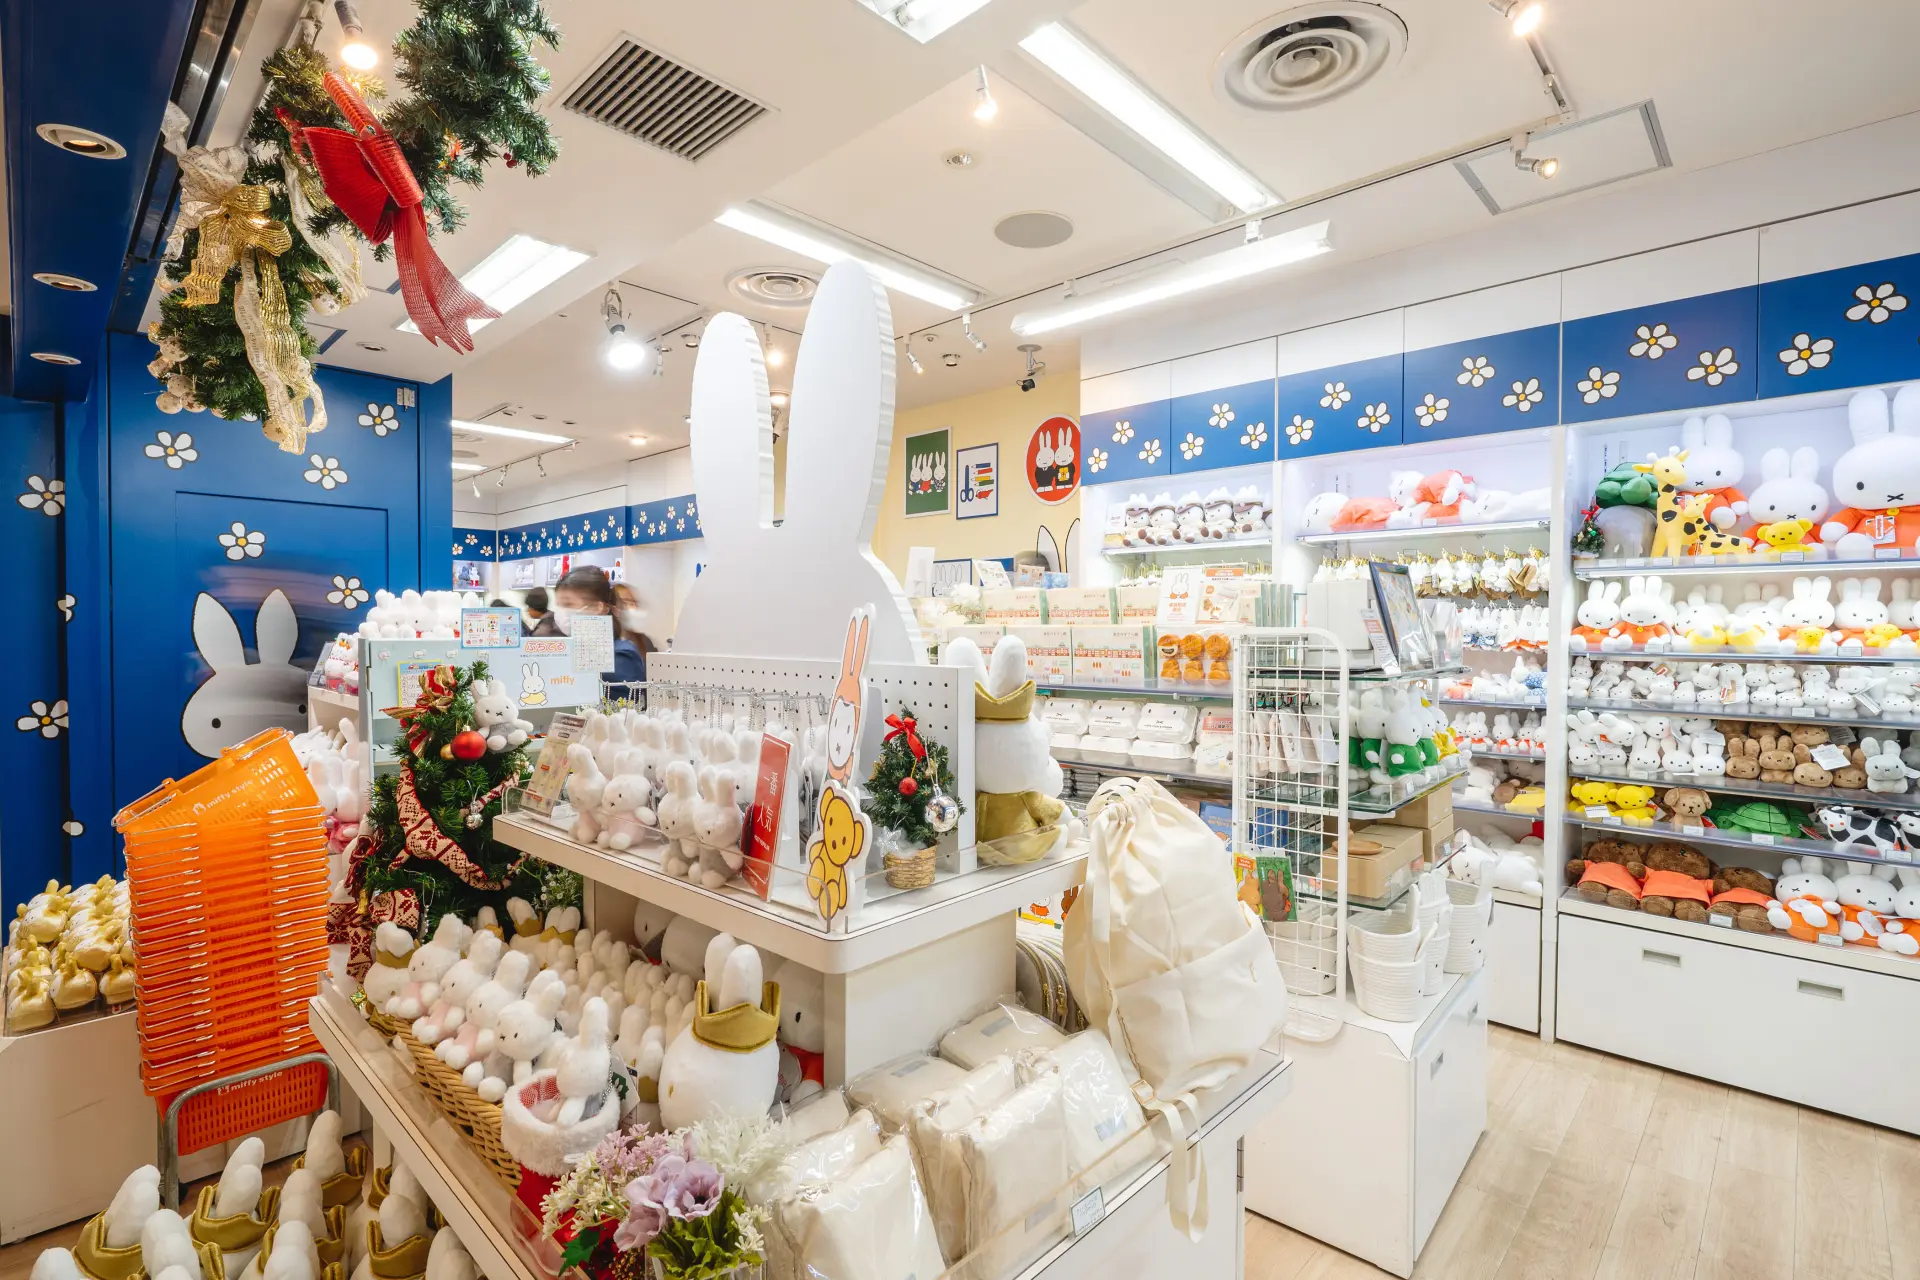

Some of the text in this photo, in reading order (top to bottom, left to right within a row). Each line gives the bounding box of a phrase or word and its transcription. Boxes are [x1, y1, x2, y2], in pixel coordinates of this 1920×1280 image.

[525, 640, 566, 653] ぷちてる
[550, 675, 575, 686] miffy
[207, 780, 253, 808] miffy style
[756, 800, 774, 833] 人気
[231, 1071, 283, 1091] miffy style
